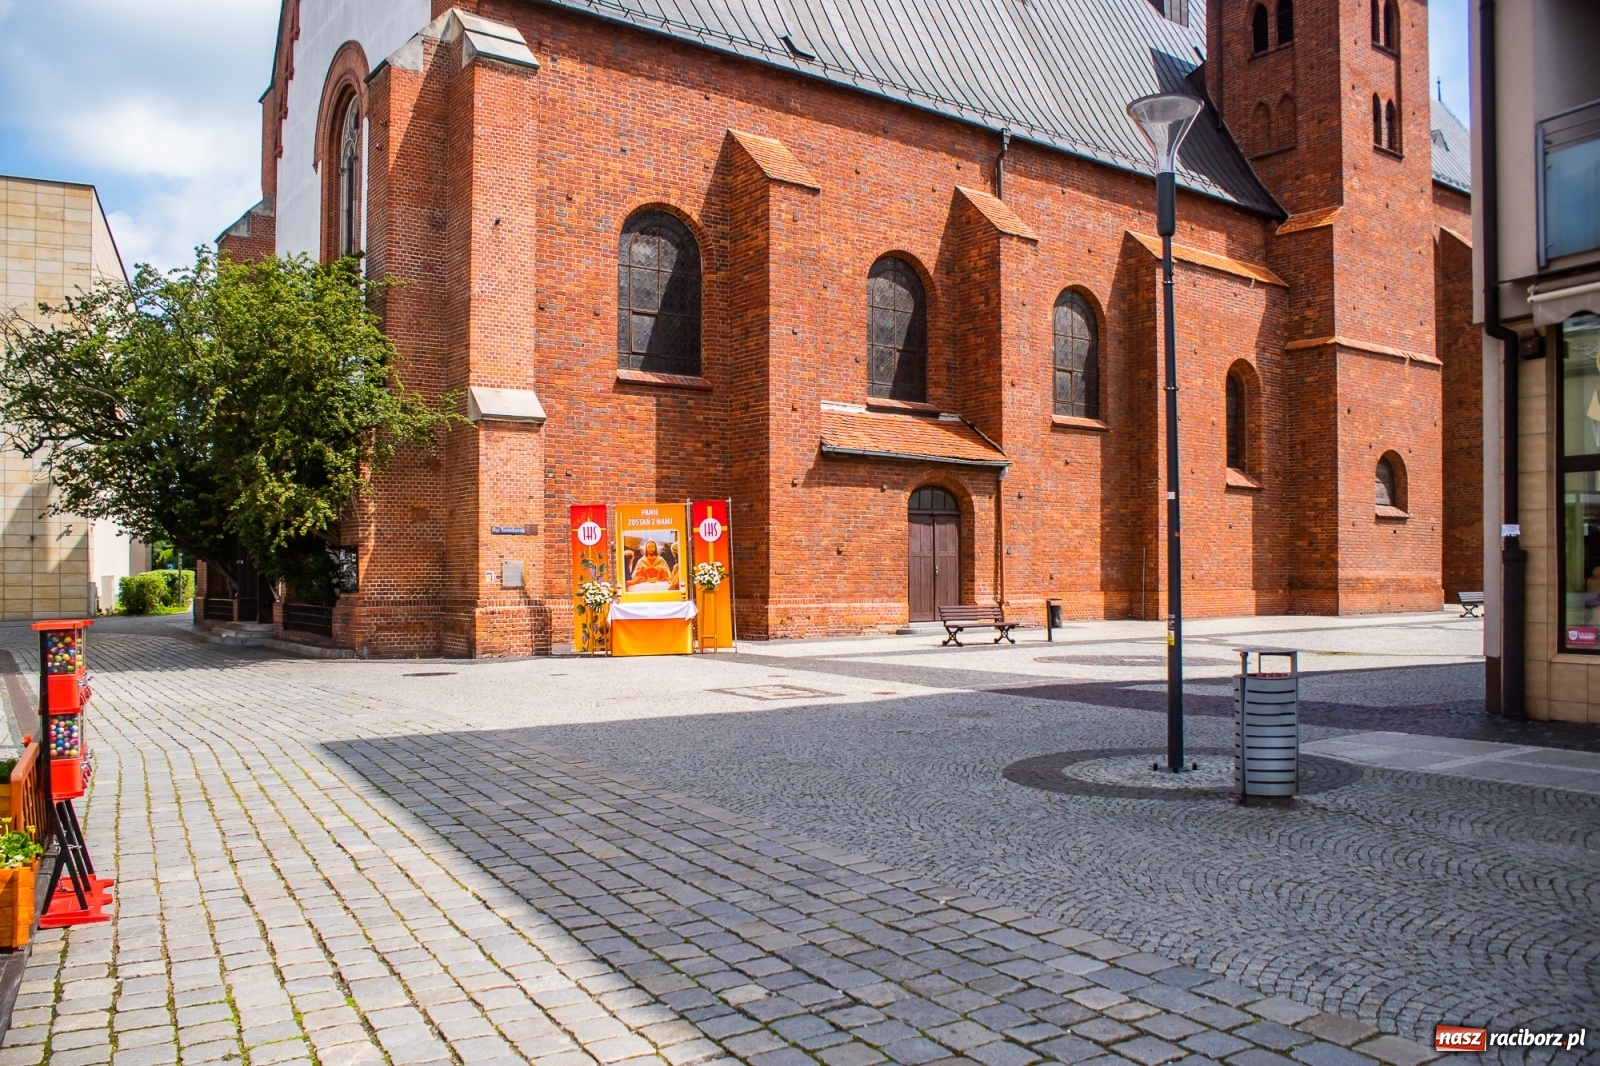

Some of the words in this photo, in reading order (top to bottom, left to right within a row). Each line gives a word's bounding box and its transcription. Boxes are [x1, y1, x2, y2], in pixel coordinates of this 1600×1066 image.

[628, 517, 650, 526] ZOSTAŃ
[583, 526, 597, 541] IHS
[704, 523, 718, 537] IHS
